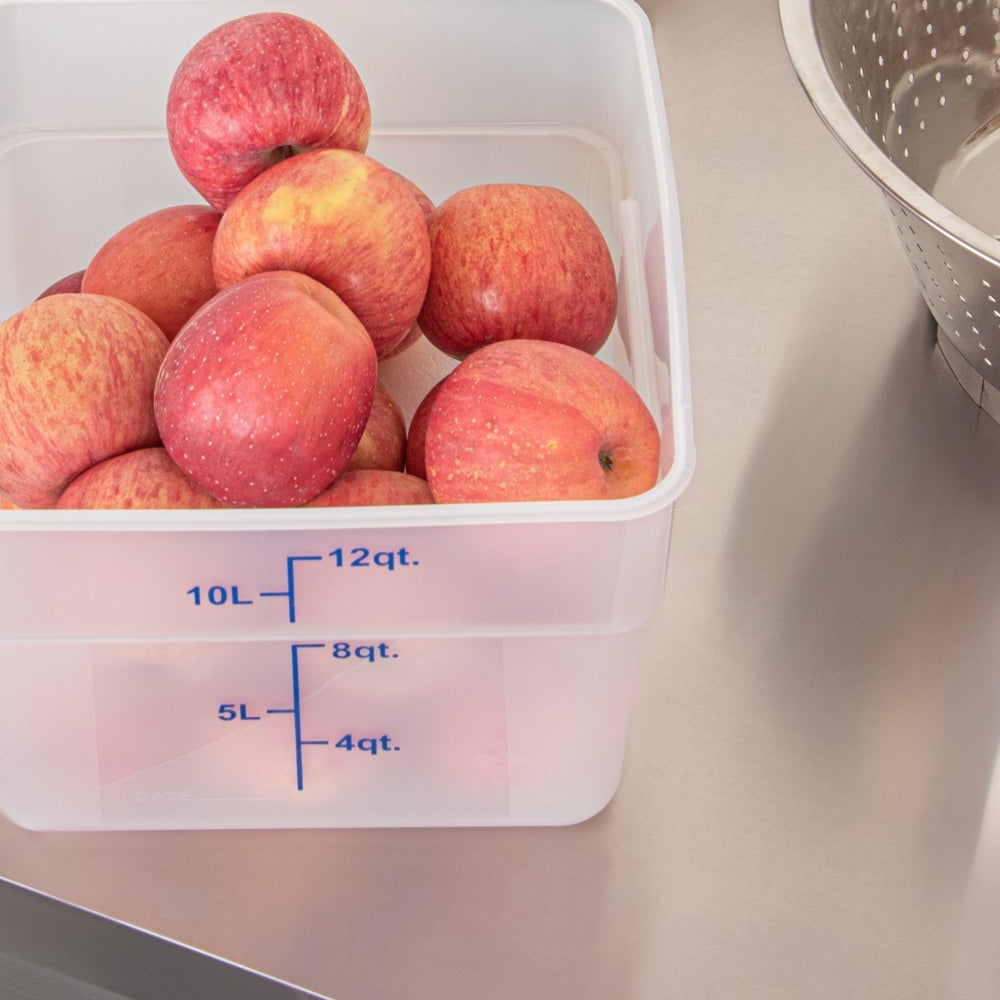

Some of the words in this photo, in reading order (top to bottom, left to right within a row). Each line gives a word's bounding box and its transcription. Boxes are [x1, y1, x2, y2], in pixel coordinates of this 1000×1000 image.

[327, 547, 420, 571] 12qt.
[186, 585, 254, 606] 10L
[331, 641, 399, 663] 8qt.
[217, 704, 262, 721] 5L
[334, 733, 401, 755] 4qt.
